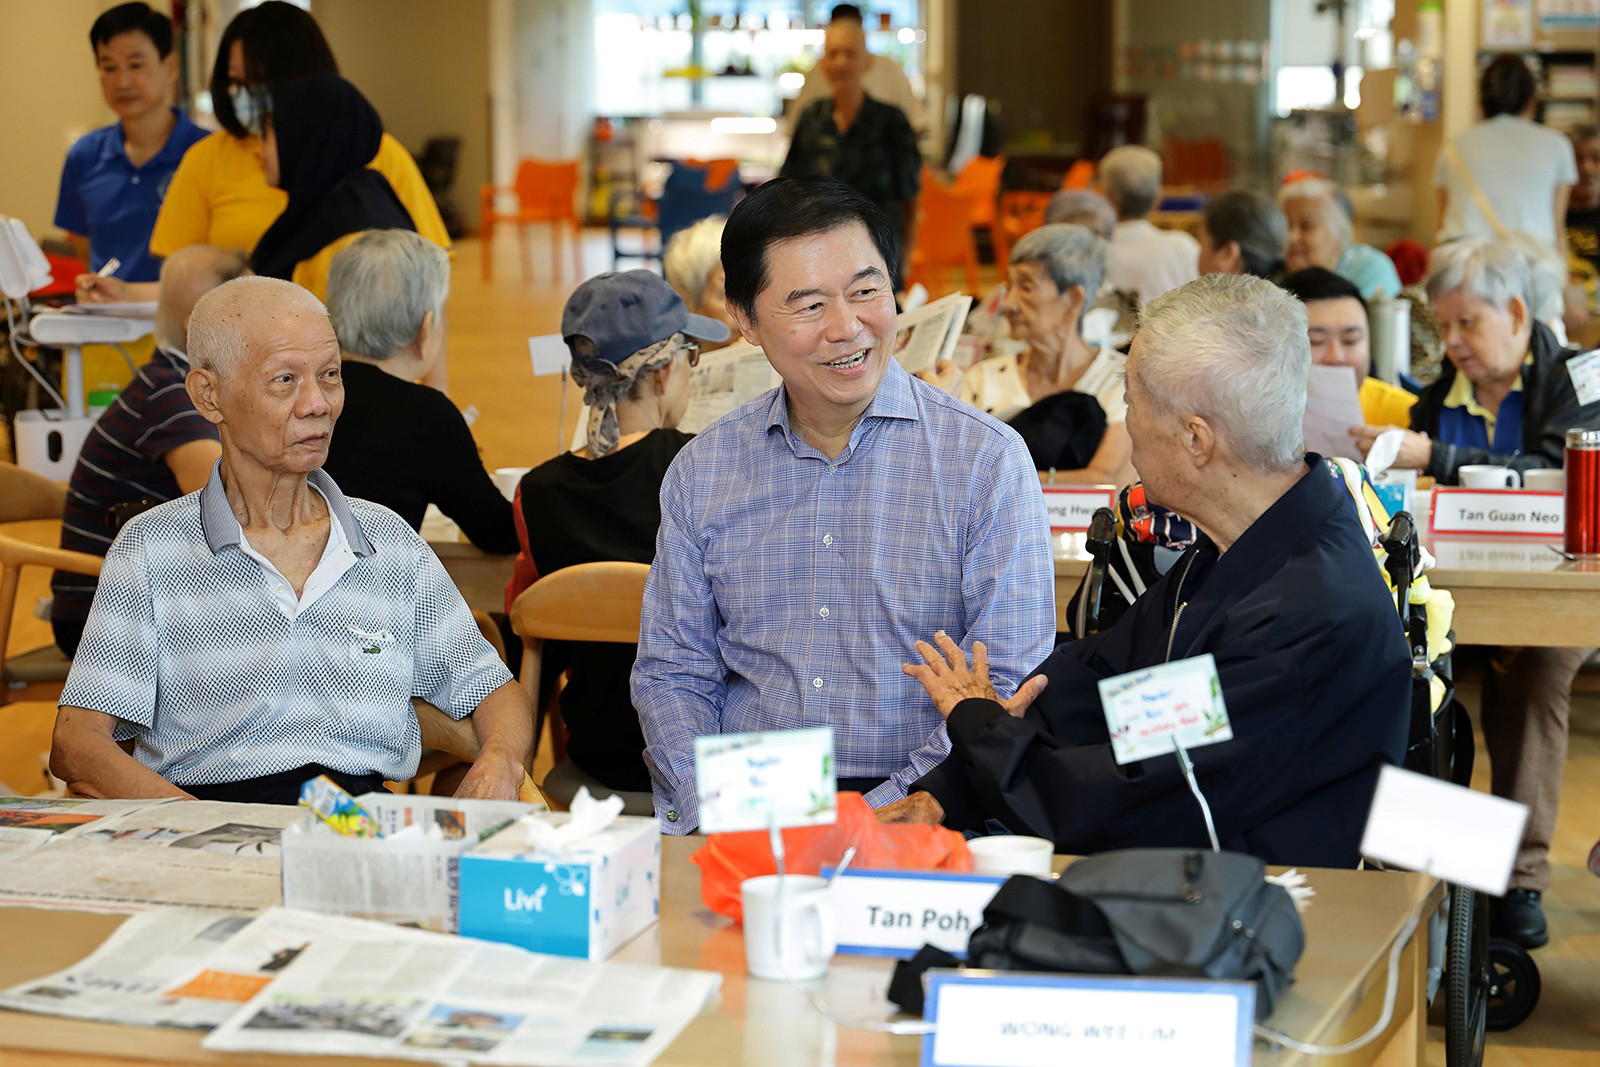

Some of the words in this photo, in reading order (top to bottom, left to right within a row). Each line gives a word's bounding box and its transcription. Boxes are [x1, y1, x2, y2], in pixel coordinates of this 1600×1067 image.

[1047, 505, 1067, 517] ong
[1459, 508, 1484, 521] Tan
[1488, 509, 1526, 522] Guan
[1530, 511, 1560, 523] Neo
[867, 905, 913, 928] Tan
[921, 908, 970, 930] Poh
